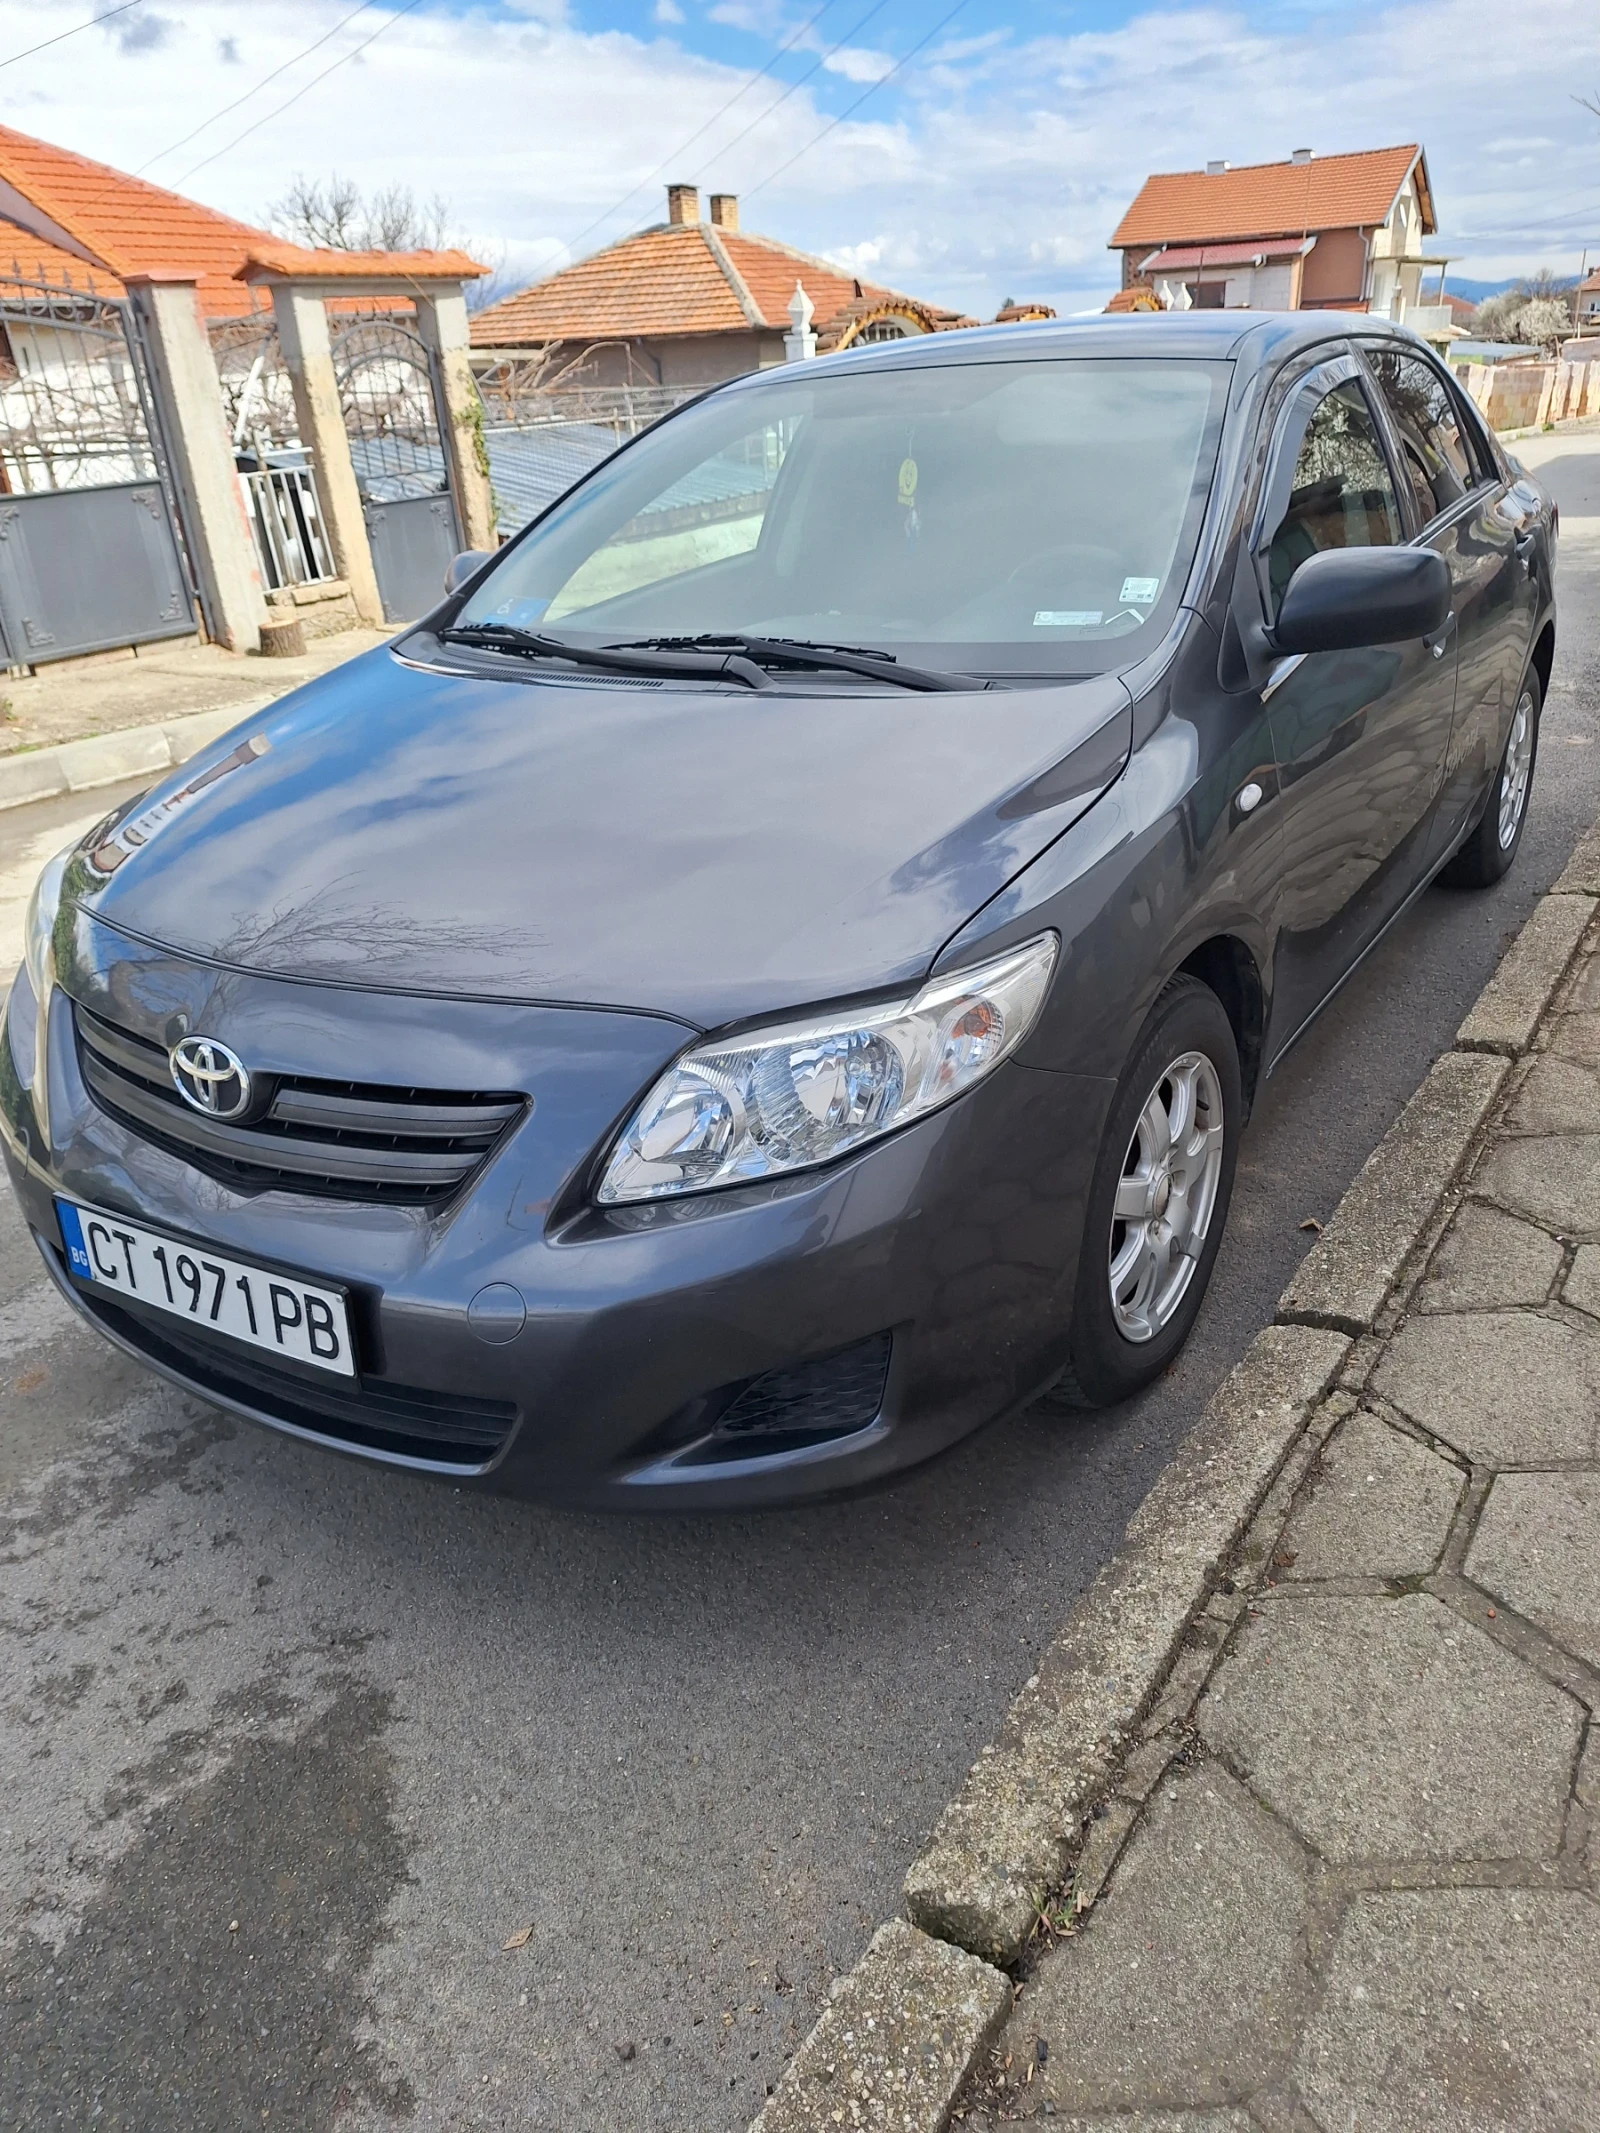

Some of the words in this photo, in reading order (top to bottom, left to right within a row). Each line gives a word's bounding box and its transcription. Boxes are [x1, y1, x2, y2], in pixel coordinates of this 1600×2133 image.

[71, 1246, 89, 1266] BG
[88, 1222, 137, 1290] CT
[153, 1246, 259, 1335] 1971
[269, 1283, 340, 1360] PB
